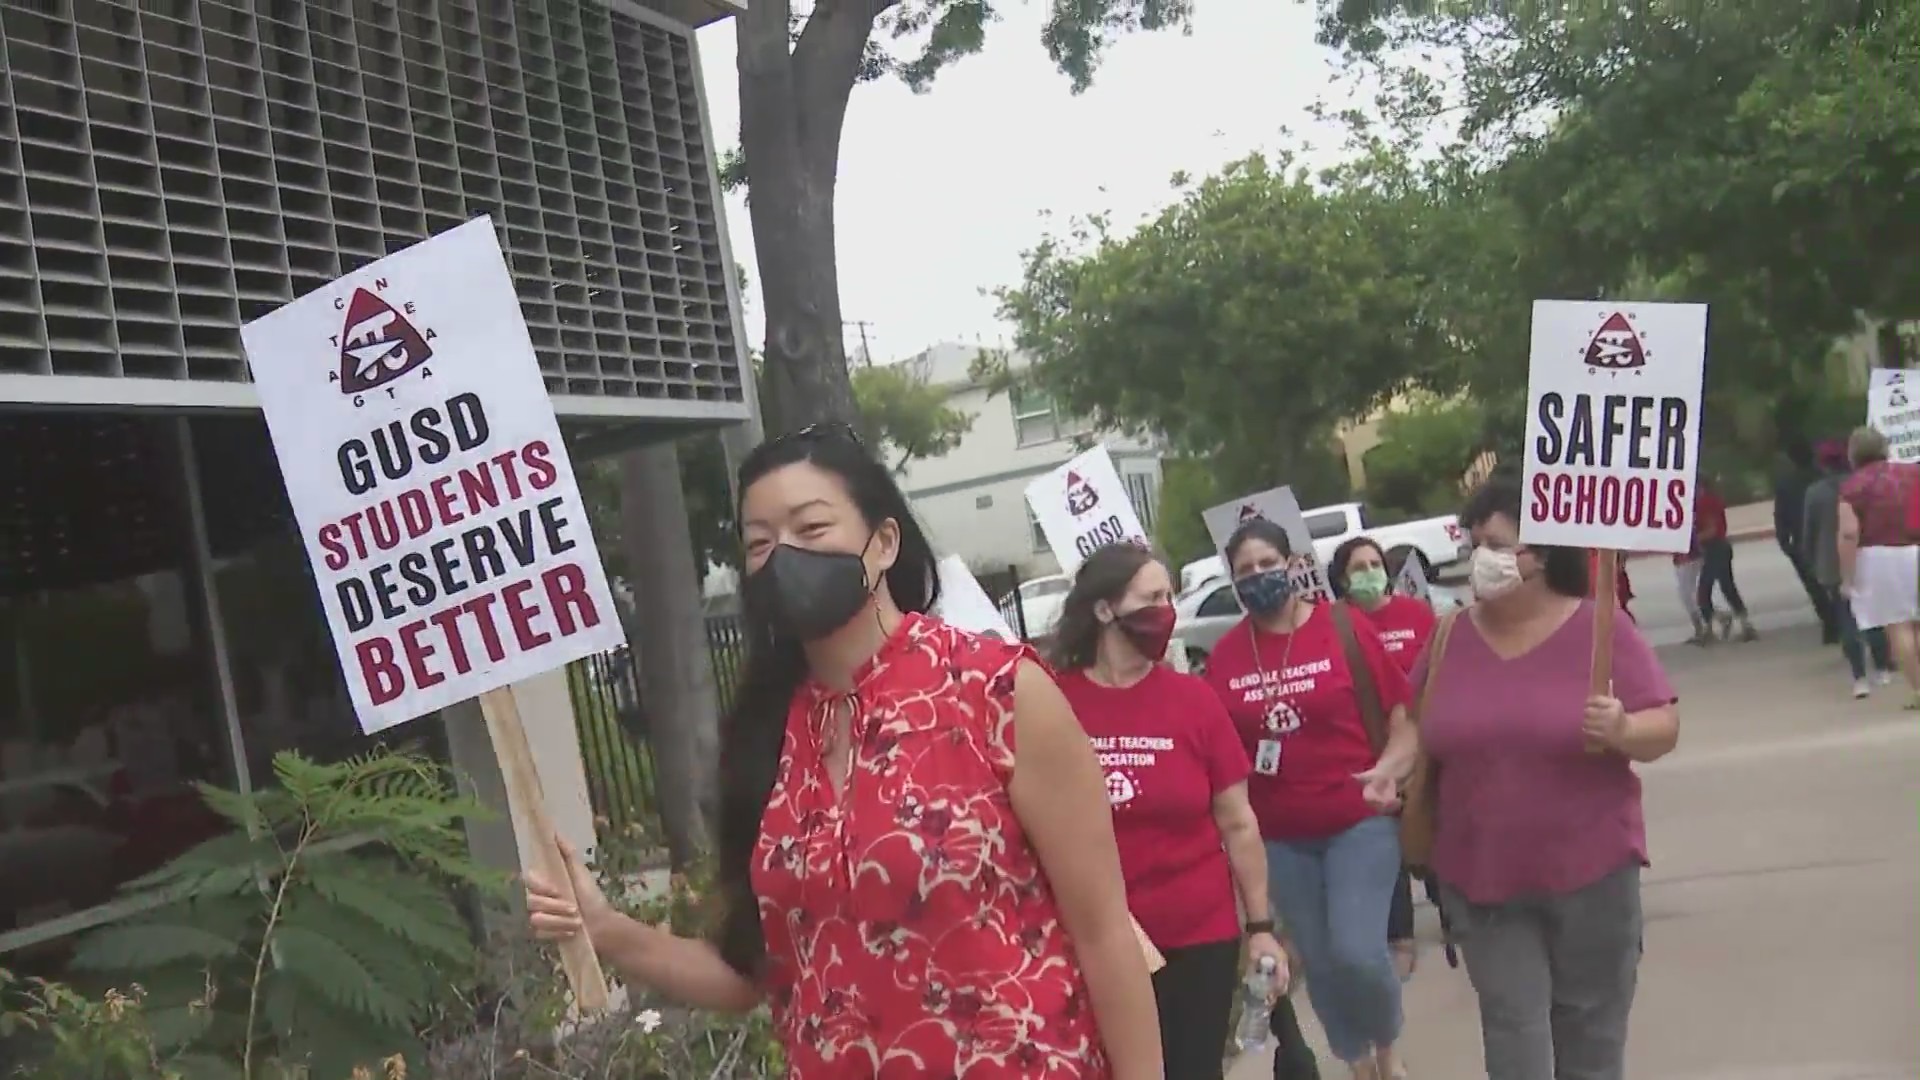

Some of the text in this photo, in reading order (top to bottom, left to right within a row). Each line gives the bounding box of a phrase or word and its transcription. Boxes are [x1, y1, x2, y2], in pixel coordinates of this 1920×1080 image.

[337, 392, 490, 496] GUSD
[1537, 391, 1688, 471] SAFER
[318, 440, 558, 572] STUDENTS
[1531, 472, 1686, 531] SCHOOLS
[335, 496, 577, 634] DESERVE
[1076, 515, 1124, 559] GUSD
[355, 562, 601, 707] BETTER
[1229, 670, 1279, 691] GLENDLE
[1097, 753, 1156, 767] OCIATION
[1118, 736, 1174, 751] TEACHERS
